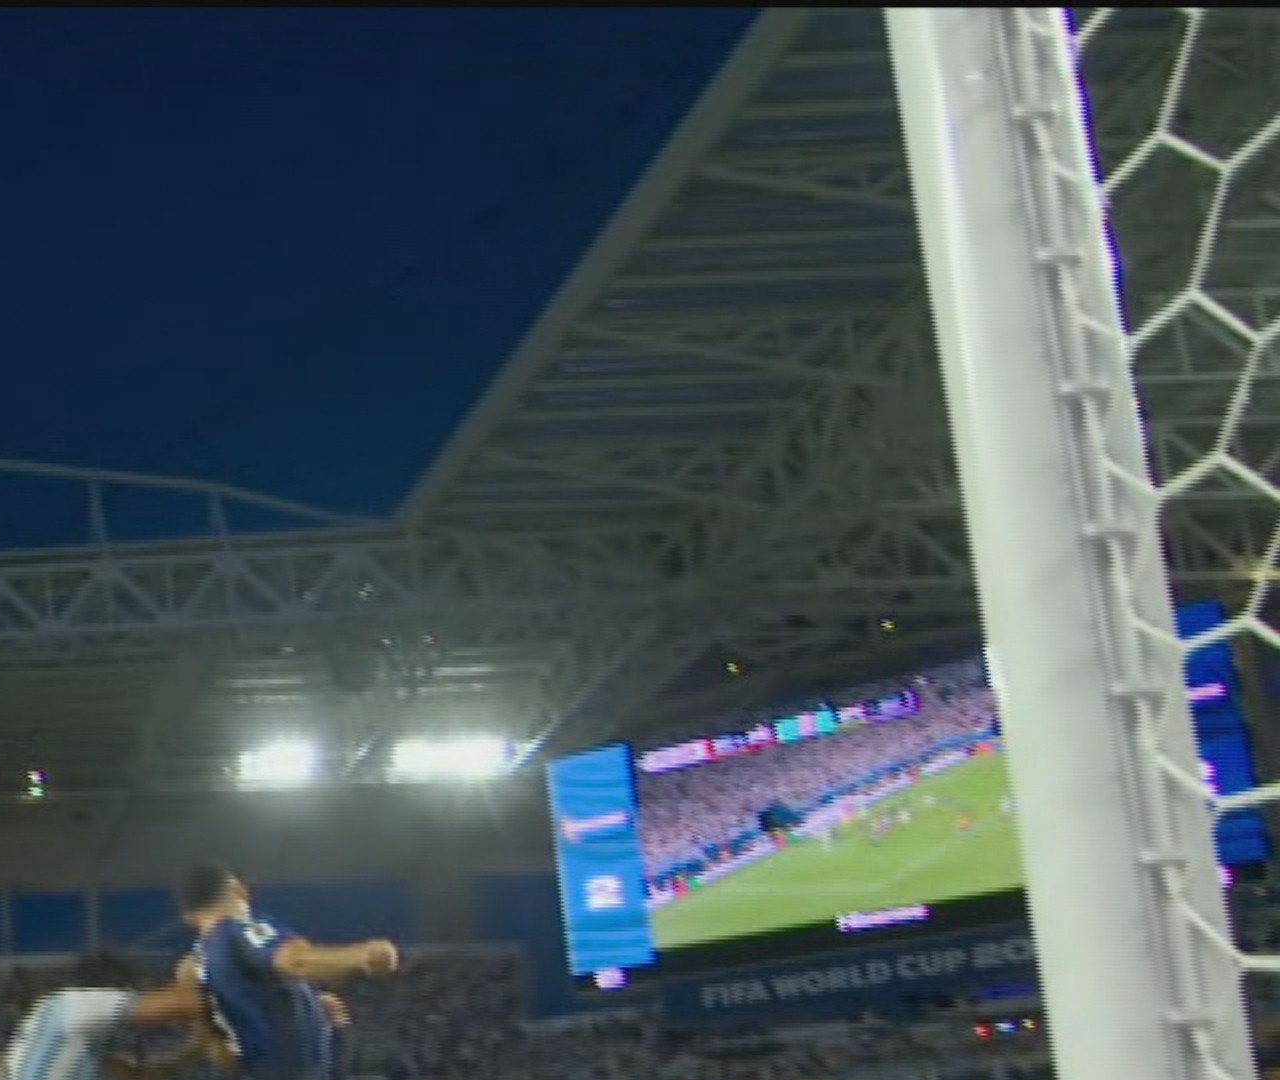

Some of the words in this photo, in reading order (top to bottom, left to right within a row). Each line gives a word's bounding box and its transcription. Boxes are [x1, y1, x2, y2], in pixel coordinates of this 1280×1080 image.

[699, 980, 771, 1009] FIFA
[772, 961, 890, 1000] WORLD
[896, 948, 968, 978] CUP
[970, 937, 1034, 969] 20
